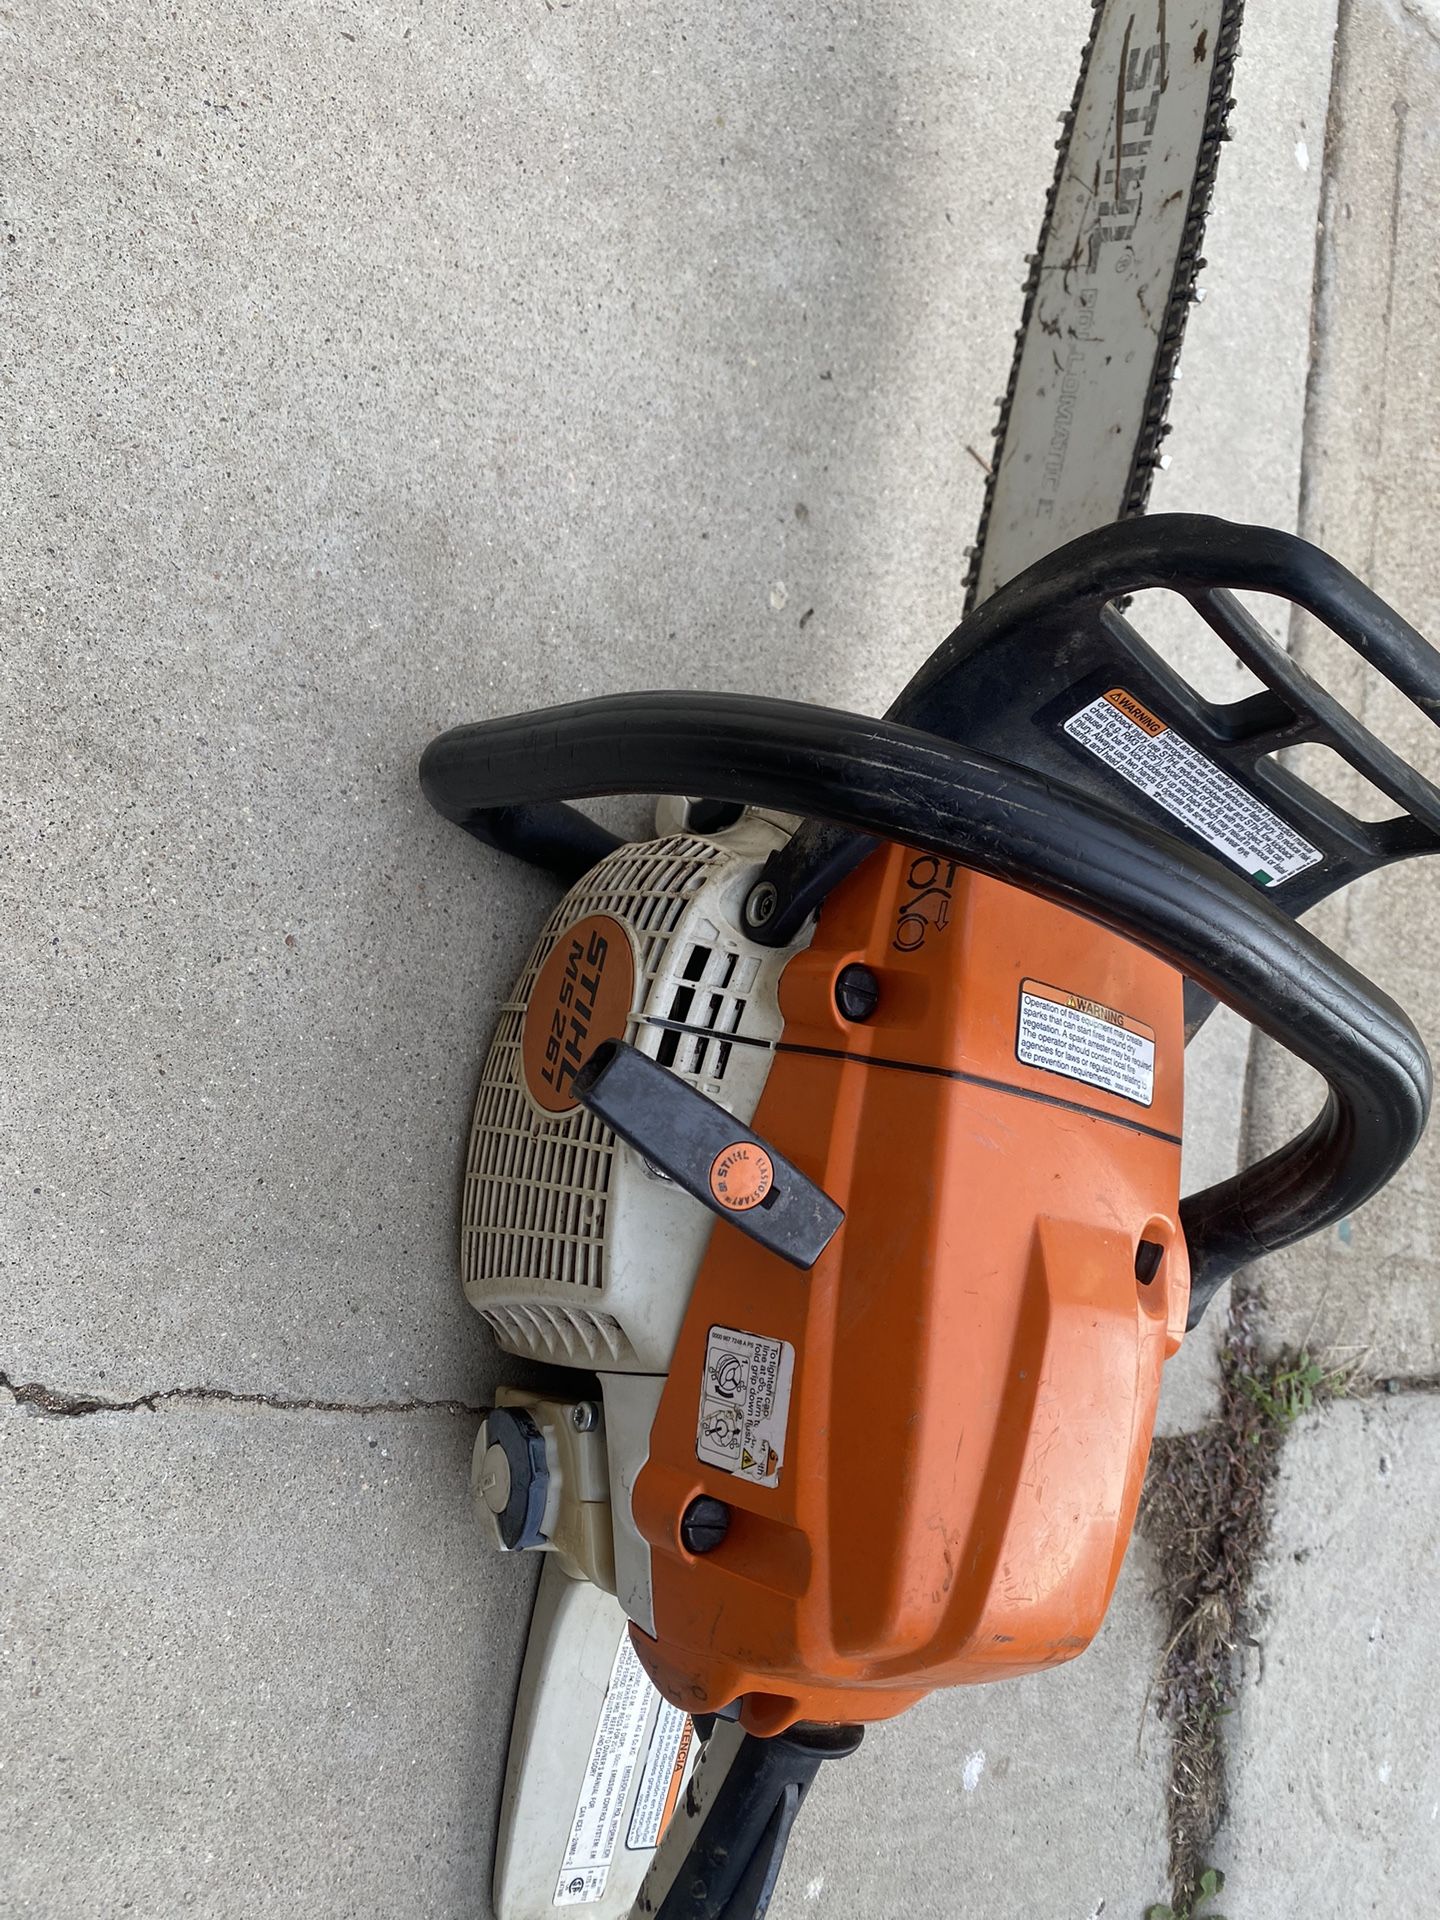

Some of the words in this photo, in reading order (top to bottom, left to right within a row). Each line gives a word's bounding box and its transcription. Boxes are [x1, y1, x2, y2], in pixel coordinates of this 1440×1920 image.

[1086, 42, 1169, 274] STIHL
[1118, 697, 1159, 731] WARNING
[1063, 723, 1091, 744] hearing
[1089, 742, 1104, 753] and
[1101, 751, 1120, 765] head
[1081, 713, 1102, 729] cause
[1100, 727, 1112, 737] the
[1111, 735, 1124, 745] bar
[1128, 749, 1143, 761] kick
[1140, 760, 1169, 781] suddenly
[1166, 780, 1177, 788] up
[1174, 787, 1190, 797] and
[1186, 795, 1202, 808] back
[1200, 806, 1218, 820] which
[1214, 819, 1230, 830] may
[1228, 828, 1245, 842] result
[1248, 845, 1269, 860] serious
[1272, 863, 1287, 874] fatal
[1089, 707, 1108, 722] chain
[1120, 731, 1139, 745] RM3
[1161, 765, 1182, 780] Avoid
[1178, 778, 1202, 796] contact
[1205, 799, 1217, 808] bar
[1222, 813, 1235, 823] with
[1233, 822, 1246, 832] any
[1262, 843, 1274, 854] This
[1272, 853, 1284, 862] can
[1091, 732, 1115, 751] Always
[1113, 749, 1127, 760] use
[1125, 758, 1138, 769] two
[1136, 767, 1156, 783] hands
[1161, 787, 1184, 805] operate
[1182, 803, 1194, 813] the
[1204, 821, 1226, 837] Always
[1224, 836, 1239, 847] wear
[1104, 707, 1132, 729] kickback
[1128, 728, 1149, 743] injury
[1147, 742, 1160, 752] use
[1158, 750, 1179, 768] STIHL
[1177, 766, 1203, 786] reduced
[1200, 784, 1225, 804] kickback
[1223, 803, 1235, 812] bar
[1233, 811, 1247, 821] and
[1244, 819, 1262, 835] STIHL
[1260, 832, 1272, 841] low
[1270, 840, 1293, 859] kickback
[1158, 738, 1186, 760] improper
[1183, 759, 1197, 769] use
[1195, 768, 1208, 778] can
[1206, 777, 1224, 792] cause
[1222, 791, 1244, 807] serious
[1248, 811, 1263, 822] fatal
[1281, 838, 1300, 853] reduce
[1298, 852, 1310, 861] risk
[1163, 730, 1183, 745] Read
[1179, 744, 1195, 755] and
[1191, 753, 1209, 768] follow
[1207, 767, 1219, 775] all
[1215, 773, 1234, 788] safety
[1230, 787, 1264, 813] precautions
[1267, 816, 1295, 838] instruction
[1293, 837, 1315, 853] manual
[559, 939, 585, 1009] MS
[556, 930, 609, 1093] STIHL
[1023, 1007, 1047, 1020] sparks
[1049, 1014, 1062, 1025] that
[1063, 1021, 1075, 1029] can
[1077, 1025, 1091, 1035] start
[1092, 1030, 1104, 1041] fires
[1106, 1036, 1125, 1049] around
[1126, 1044, 1135, 1055] dry
[1024, 995, 1058, 1013] Operation
[1060, 1008, 1066, 1016] of
[1068, 1011, 1079, 1021] this
[1113, 1029, 1124, 1040] may
[1078, 1000, 1123, 1025] WARNING
[541, 1008, 567, 1086] 261
[1020, 1048, 1032, 1058] fire
[1033, 1053, 1069, 1069] prevention
[1021, 1039, 1052, 1054] agencies
[1054, 1048, 1064, 1057] for
[1065, 1052, 1079, 1063] laws
[1089, 1061, 1120, 1078] regulations
[1022, 1018, 1059, 1035] vegetation.
[1061, 1029, 1067, 1037] A
[1069, 1032, 1086, 1044] spark
[1087, 1039, 1109, 1052] arrester
[1110, 1049, 1123, 1059] may
[1124, 1053, 1130, 1061] be
[1022, 1026, 1036, 1038] The
[1038, 1033, 1066, 1047] operator
[1068, 1043, 1089, 1056] should
[1090, 1051, 1111, 1064] contact
[1113, 1059, 1125, 1070] local
[1127, 1064, 1135, 1074] fire
[717, 1149, 749, 1177] STIHL
[750, 1364, 758, 1384] grip
[753, 1343, 761, 1362] fold
[759, 1364, 765, 1375] at
[761, 1345, 769, 1362] line
[769, 1347, 778, 1359] To
[747, 1387, 756, 1415] down
[744, 1419, 753, 1445] flush.
[674, 1714, 695, 1771] RTENCIA
